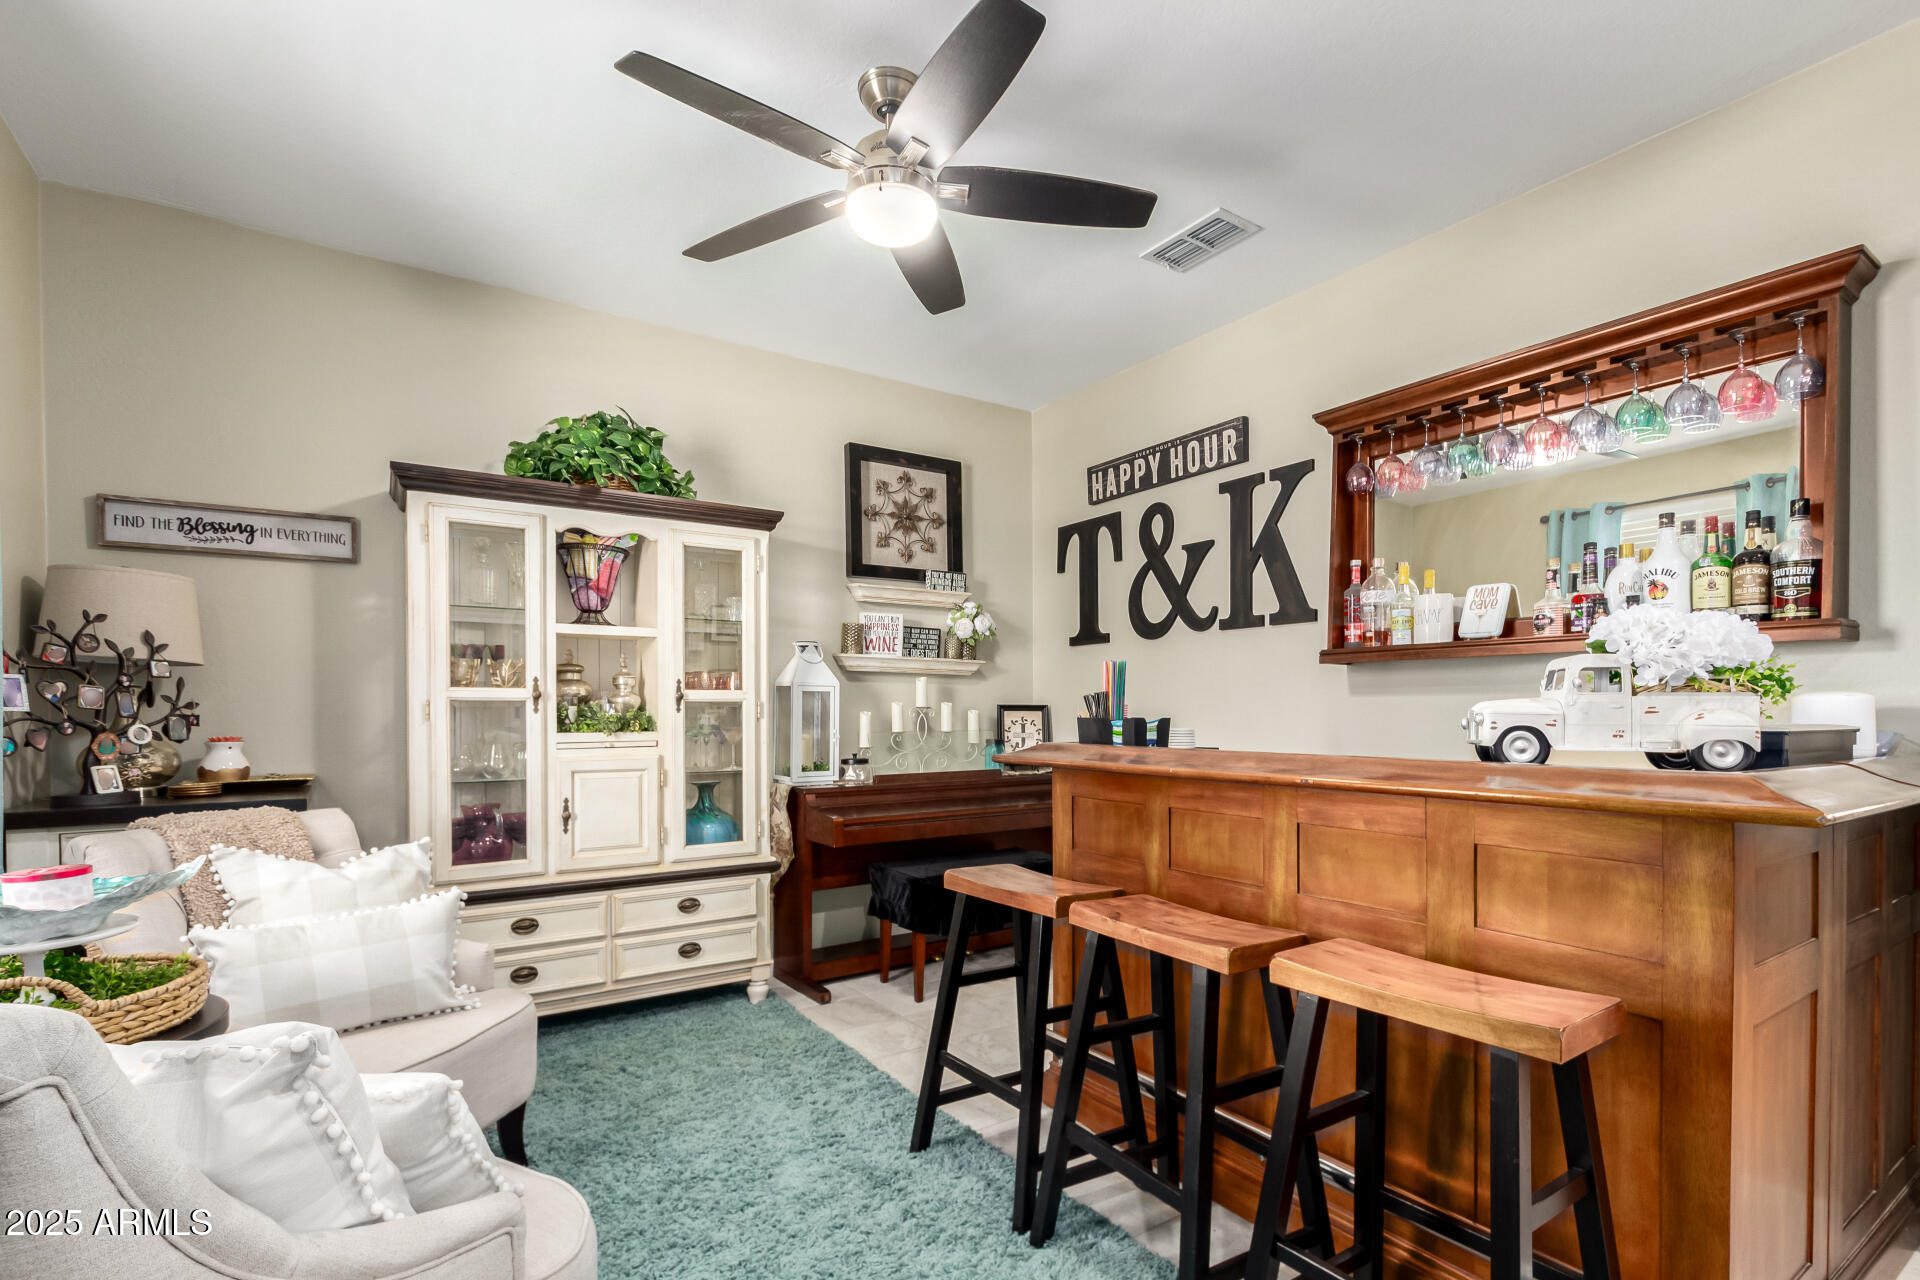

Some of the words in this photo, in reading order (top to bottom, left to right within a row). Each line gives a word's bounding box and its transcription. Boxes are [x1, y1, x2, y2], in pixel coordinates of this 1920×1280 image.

[1135, 449, 1153, 458] EVERY
[1155, 442, 1172, 451] HOUR
[1091, 452, 1161, 501] HAPPY
[1169, 428, 1237, 479] HOUR
[113, 513, 145, 528] FIND
[151, 517, 174, 531] THE
[176, 516, 258, 545] Blessing
[260, 526, 272, 539] IN
[277, 527, 346, 546] EVERYTHING
[1643, 568, 1680, 580] MALIBU
[1694, 569, 1730, 581] JAMESON
[1733, 567, 1769, 579] JAMESON
[1772, 566, 1815, 579] SOUTHERN
[1774, 575, 1812, 587] COMFORT
[1473, 586, 1500, 600] MOM
[1469, 598, 1498, 611] cave
[875, 615, 890, 623] CAN'T
[891, 616, 900, 624] BUY
[864, 622, 900, 632] HAPPINESS
[864, 636, 899, 653] WINE
[911, 649, 924, 657] DOES
[925, 649, 938, 658] THAT
